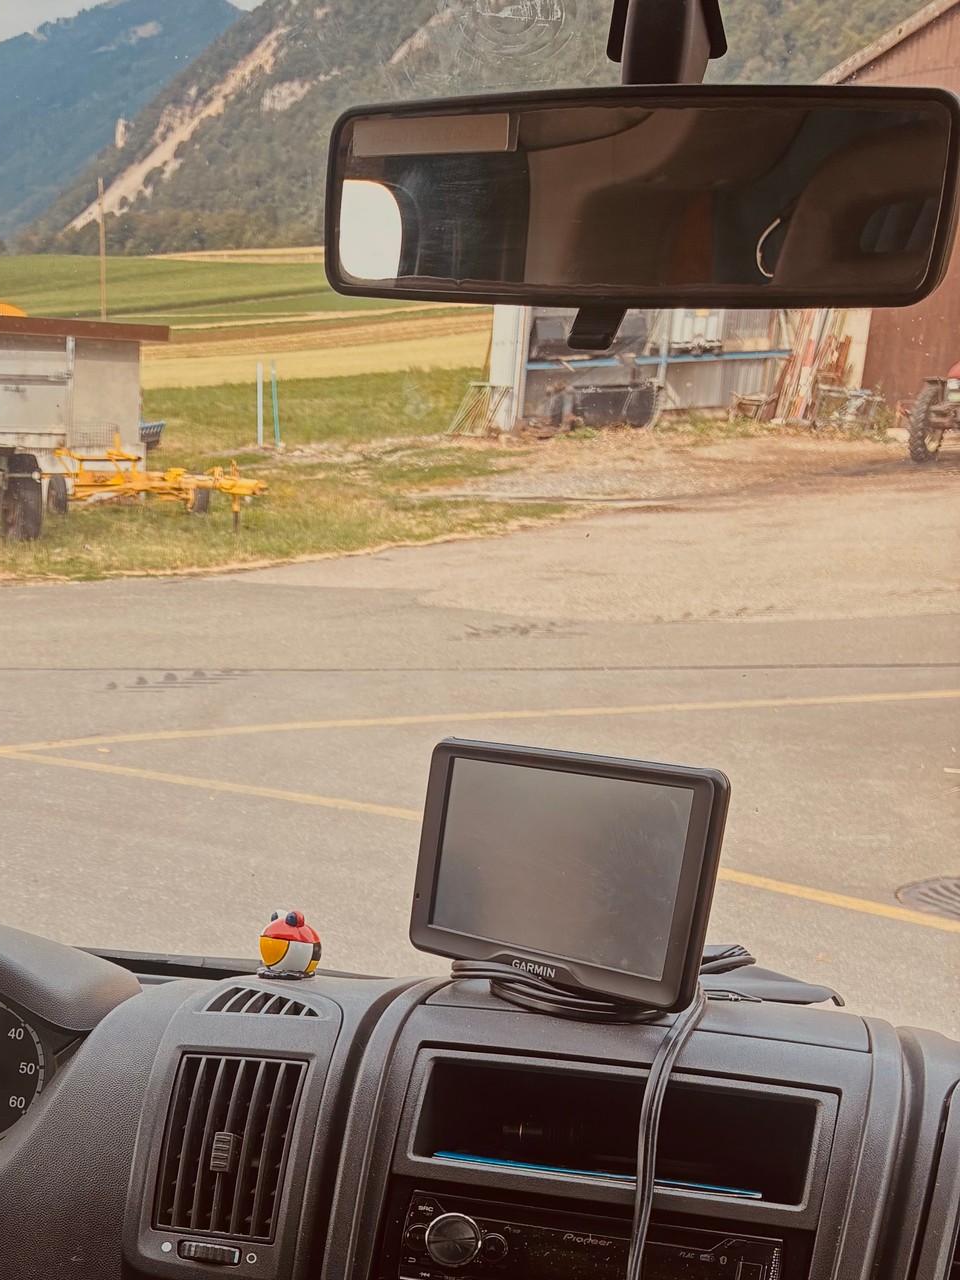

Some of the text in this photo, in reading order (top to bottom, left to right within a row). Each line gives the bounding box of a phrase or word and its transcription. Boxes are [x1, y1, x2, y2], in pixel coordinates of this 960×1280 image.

[511, 958, 556, 979] GARMIN
[8, 1028, 24, 1040] 40
[19, 1062, 35, 1074] 50
[9, 1096, 26, 1108] 60
[562, 1232, 613, 1247] Pioneer
